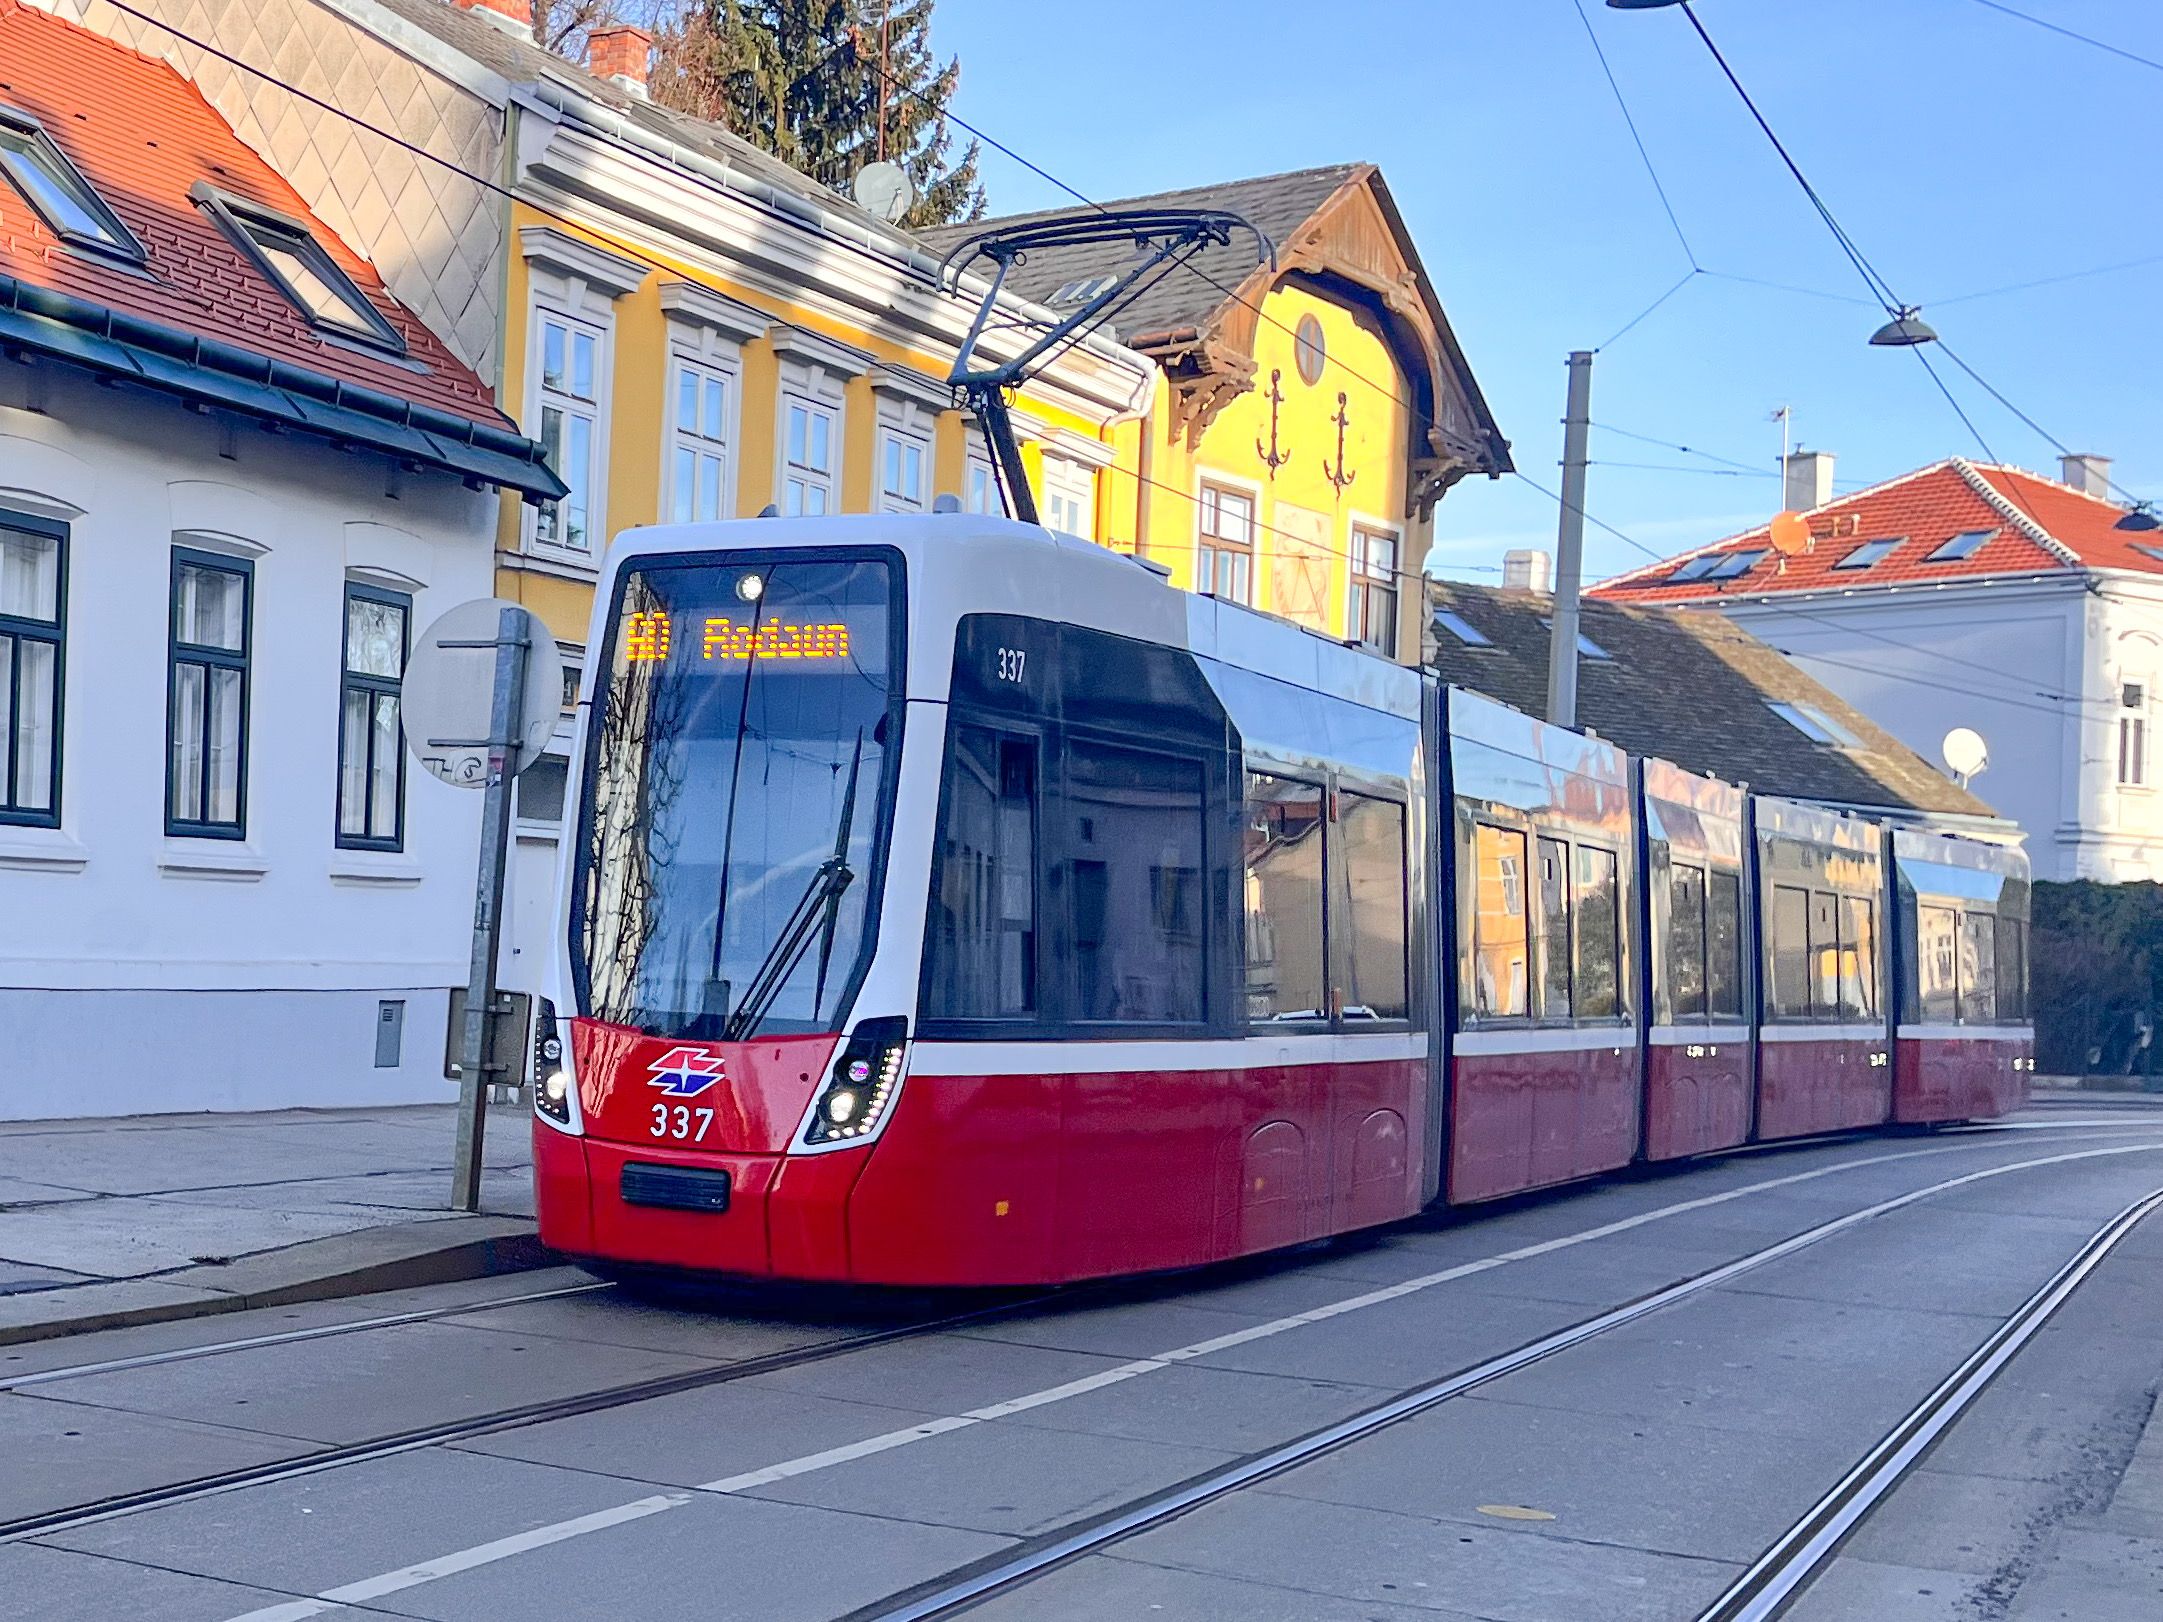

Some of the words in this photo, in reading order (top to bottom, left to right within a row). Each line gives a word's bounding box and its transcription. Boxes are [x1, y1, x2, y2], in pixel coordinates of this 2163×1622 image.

[703, 617, 848, 660] Rodaun
[998, 647, 1026, 683] 337
[649, 1103, 714, 1143] 337
